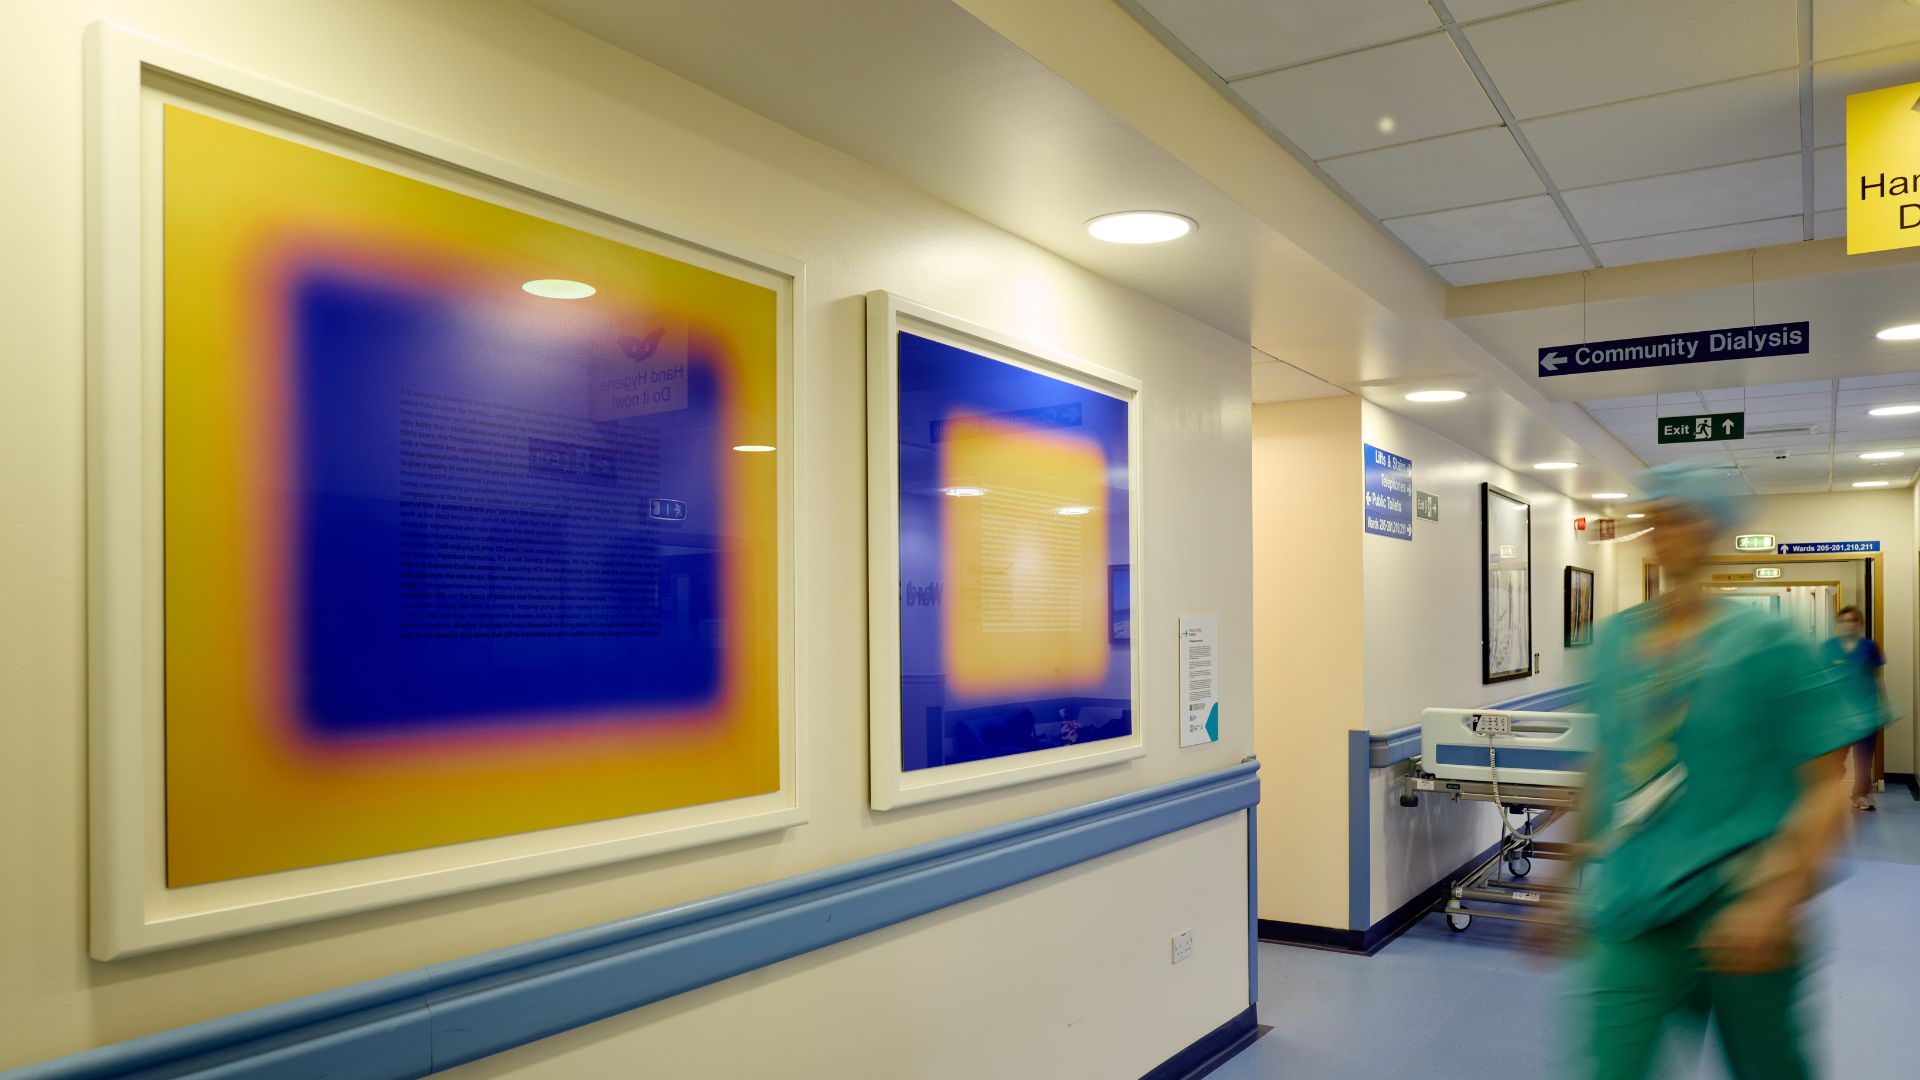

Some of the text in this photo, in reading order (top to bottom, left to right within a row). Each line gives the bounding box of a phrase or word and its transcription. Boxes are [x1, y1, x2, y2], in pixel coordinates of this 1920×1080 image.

[1575, 327, 1803, 366] Community Dialysis
[1664, 425, 1690, 435] Exit
[1375, 450, 1386, 466] Lifts
[1393, 456, 1406, 472] Stairs
[1381, 473, 1406, 493] Telephones
[1372, 492, 1401, 512] Public Toilets
[1816, 544, 1873, 552] 205-201,210,211
